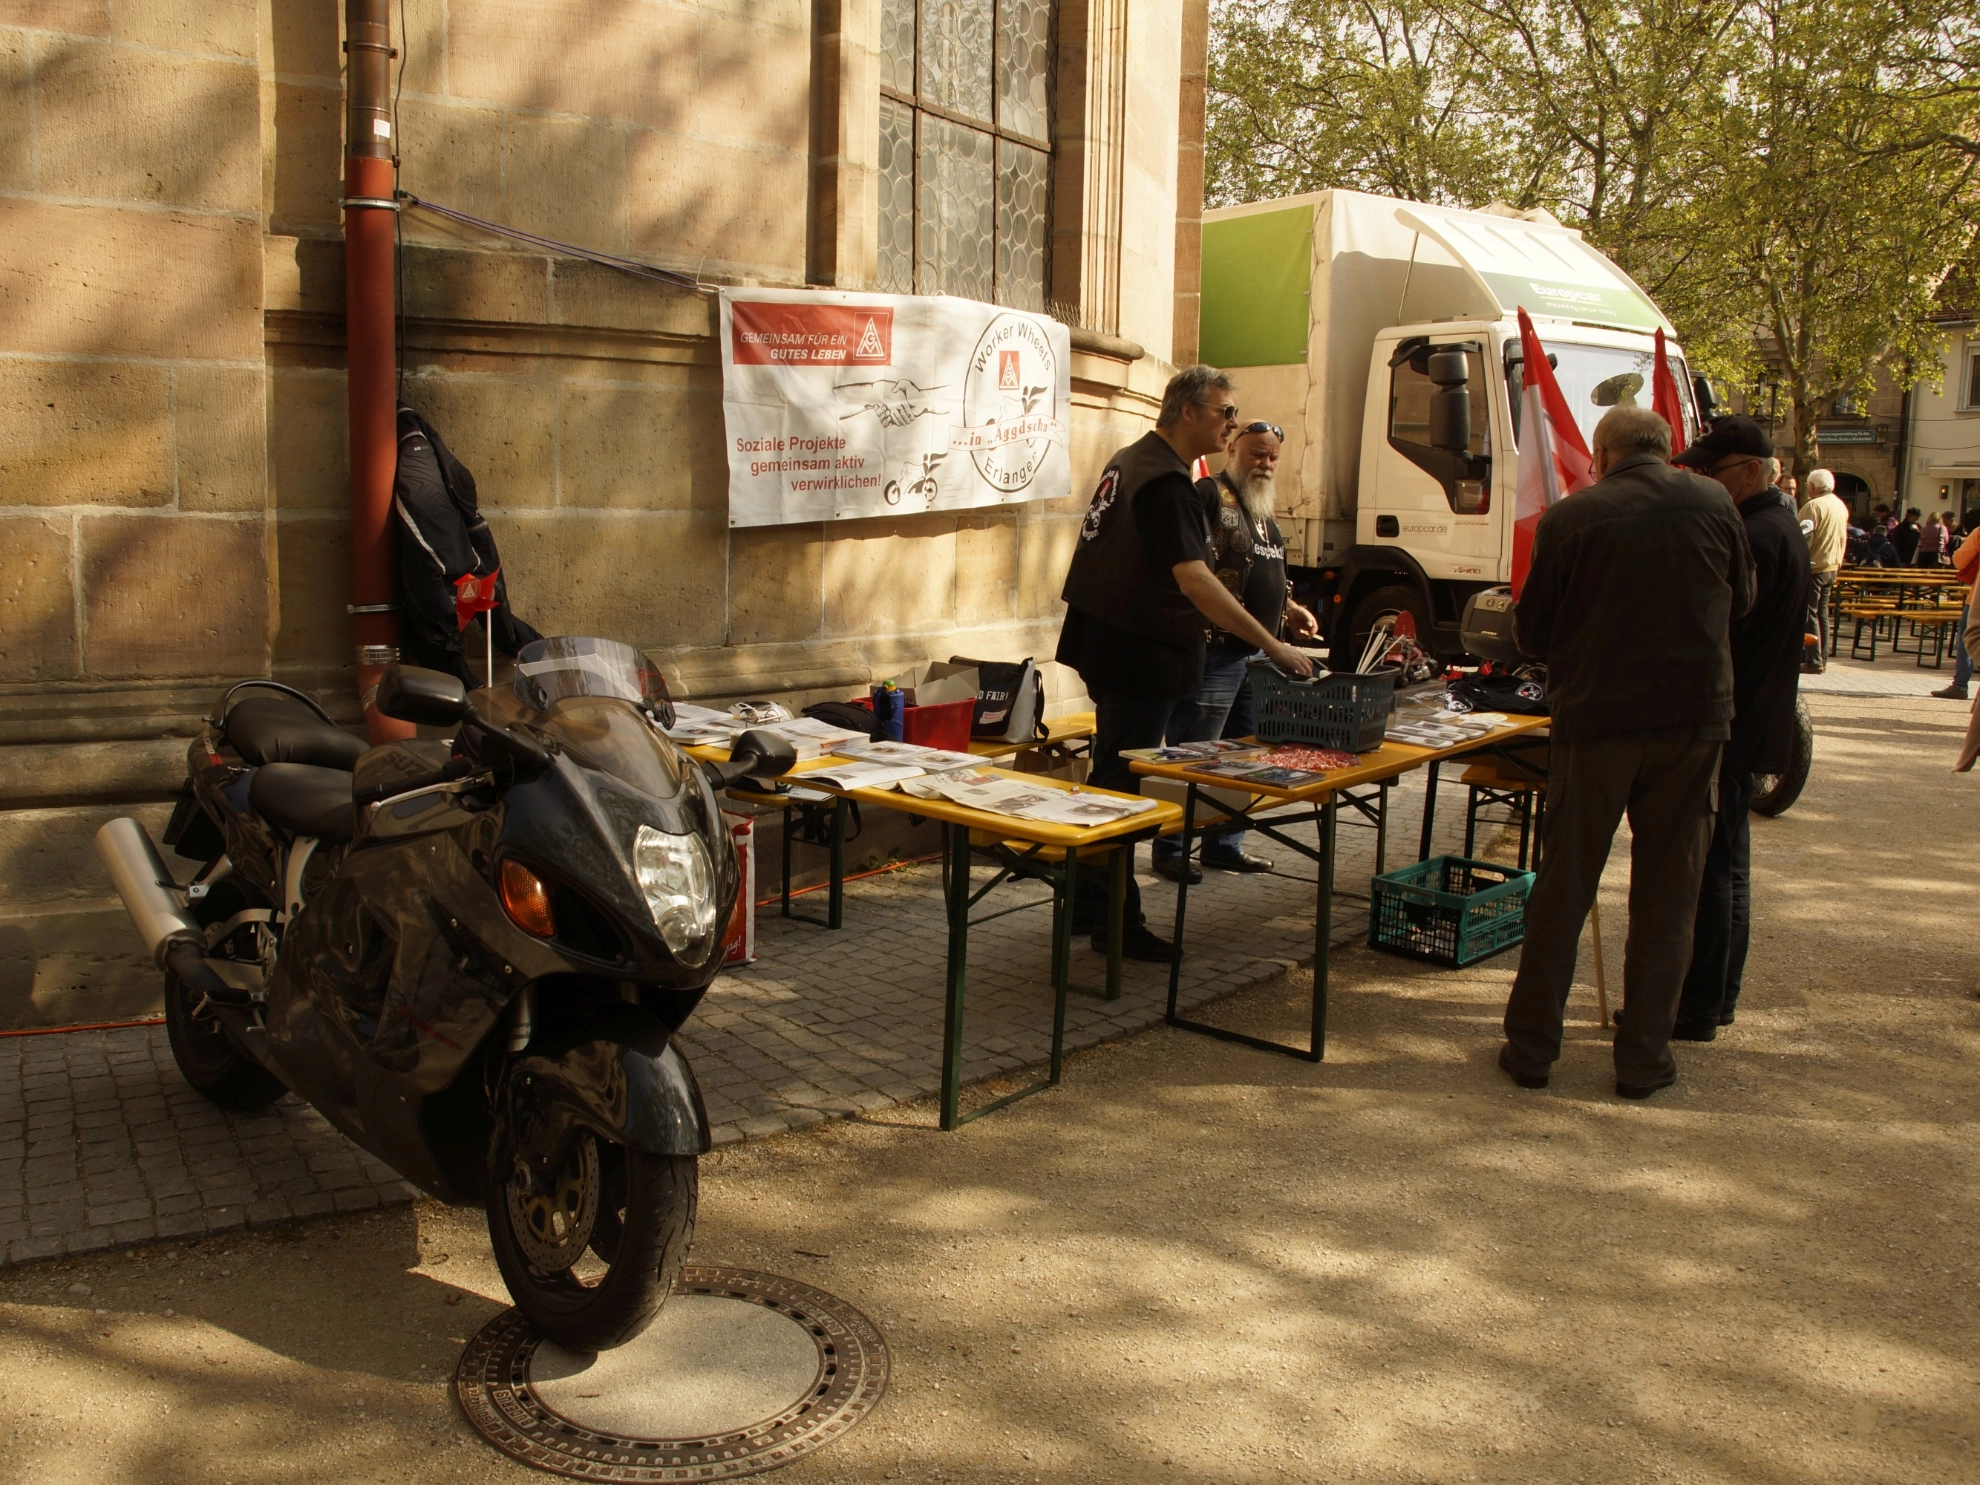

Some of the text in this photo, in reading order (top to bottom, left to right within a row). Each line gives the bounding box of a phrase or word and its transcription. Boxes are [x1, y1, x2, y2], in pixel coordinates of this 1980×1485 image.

[1529, 282, 1602, 302] Europcar
[740, 332, 848, 346] GEMEINSAM FÜR EIN
[975, 321, 1051, 373] Worker Wheels
[770, 349, 846, 360] GUTES LEBEN
[736, 435, 846, 455] Soziale Projekte
[750, 456, 865, 476] gemeinsam aktiv
[791, 473, 881, 491] verwirklichen!
[1403, 525, 1447, 534] europcar.de
[497, 1391, 535, 1426] BUDERUS
